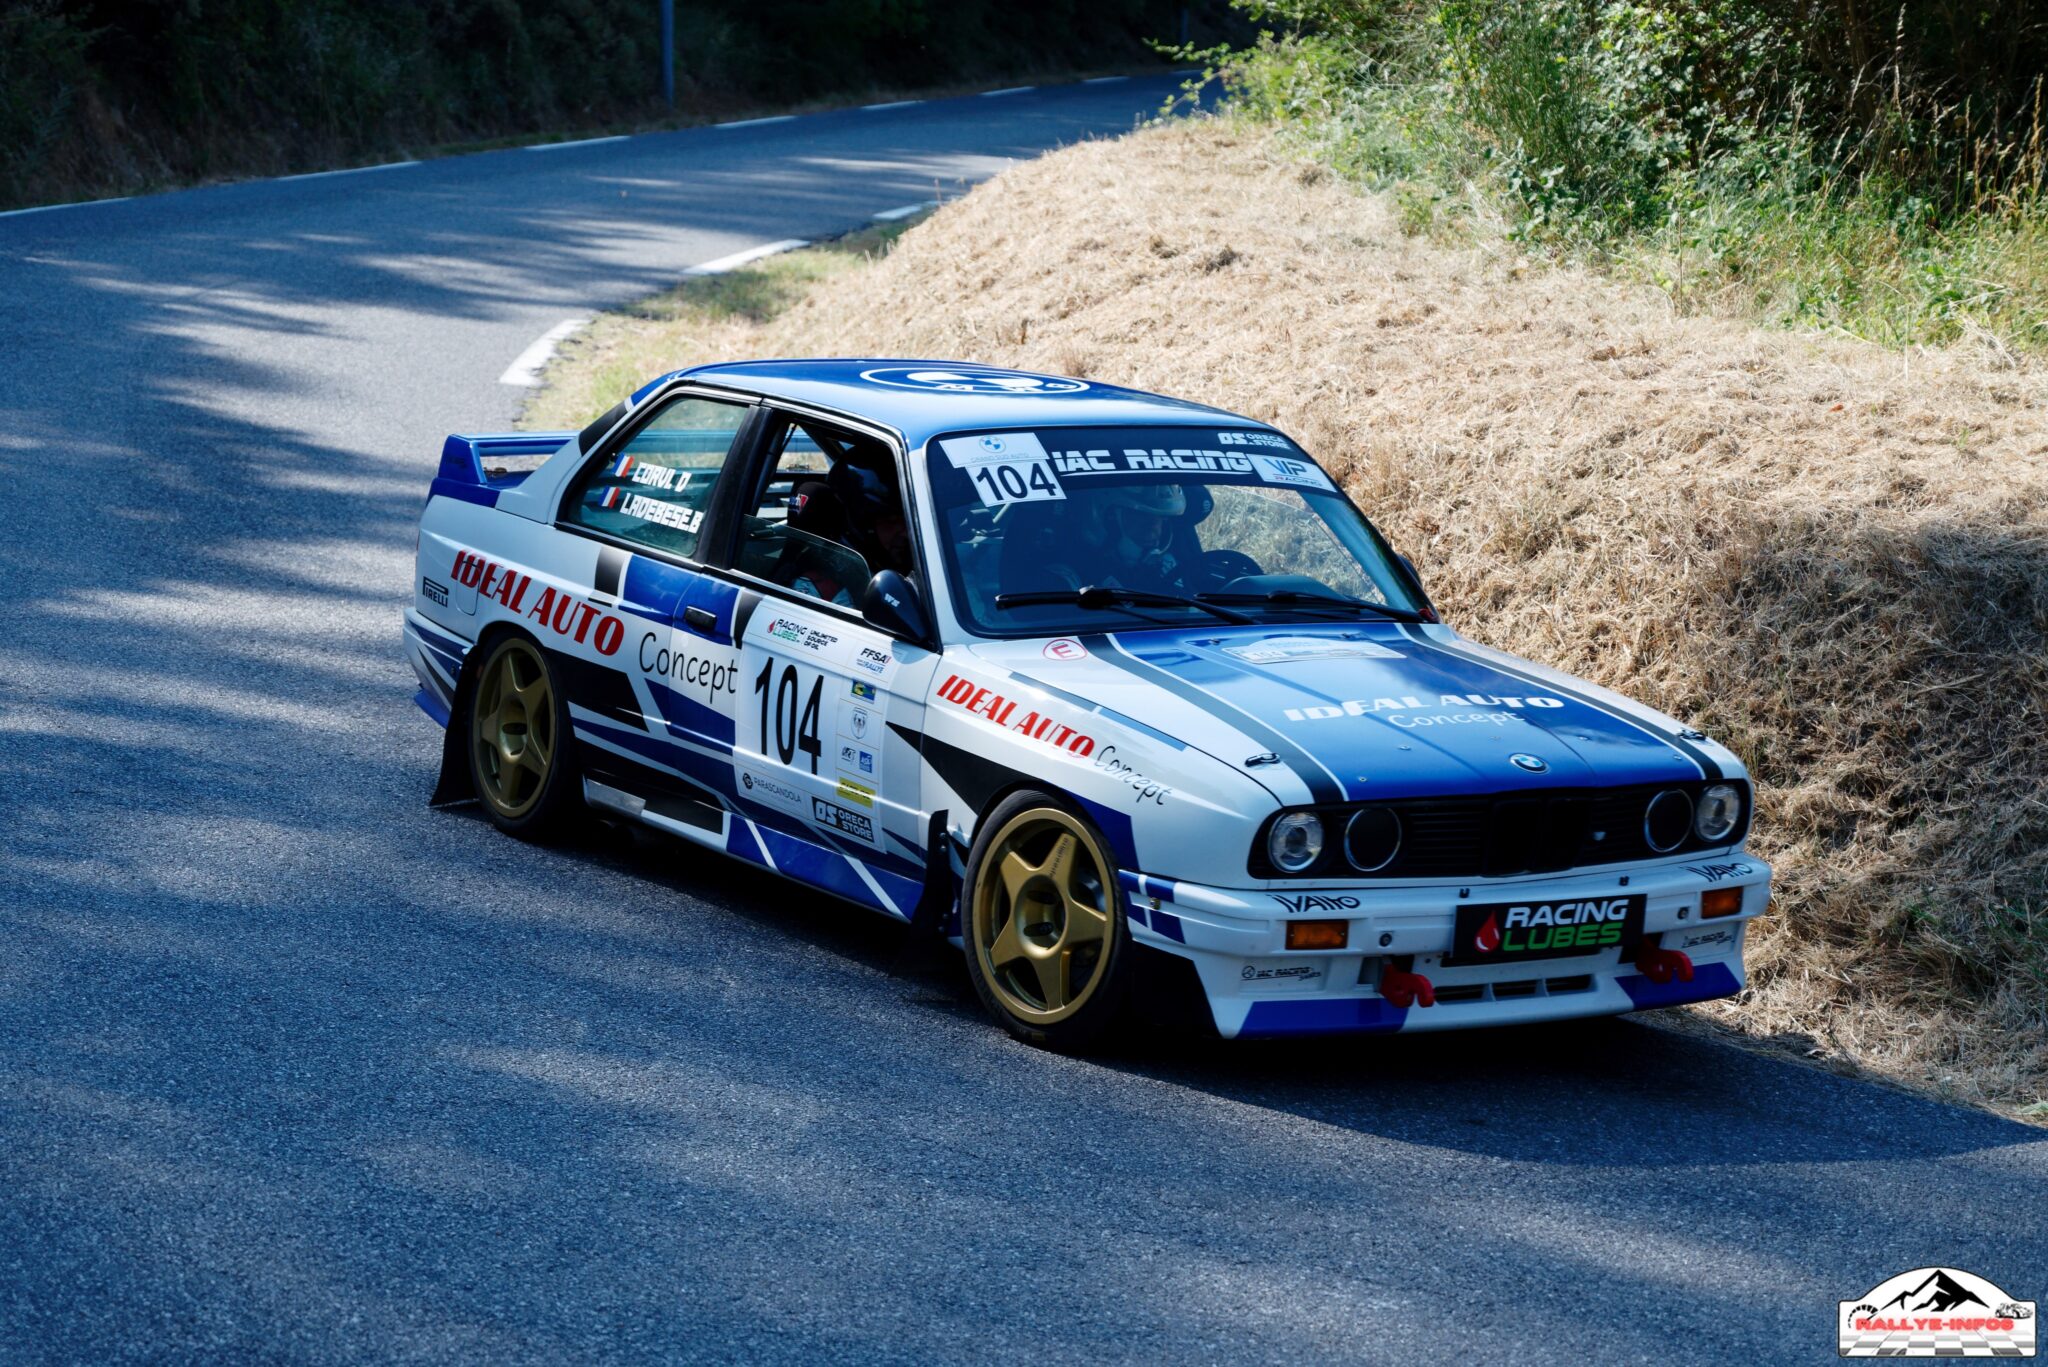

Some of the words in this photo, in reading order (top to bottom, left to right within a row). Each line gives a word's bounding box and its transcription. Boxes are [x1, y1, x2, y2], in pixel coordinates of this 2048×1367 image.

[1123, 449, 1253, 472] RACING
[976, 462, 1056, 501] 104
[422, 576, 449, 608] PIRELLI
[450, 550, 532, 614] IDEAL
[527, 586, 626, 657] AUTO
[638, 631, 739, 704] Concept
[860, 647, 886, 664] FFSA
[755, 657, 824, 777] 104
[936, 674, 1018, 727] IDEAL
[1012, 711, 1096, 758] AUTO
[1284, 696, 1431, 721] IDEAL
[1440, 695, 1567, 709] AUTO
[1387, 709, 1526, 729] Concept
[754, 777, 802, 803] PARASCANDOLA
[1095, 745, 1172, 806] Concept
[838, 810, 871, 830] ORECA
[842, 822, 873, 841] STORE
[1505, 899, 1630, 929] RACING
[1503, 922, 1624, 951] LUBES
